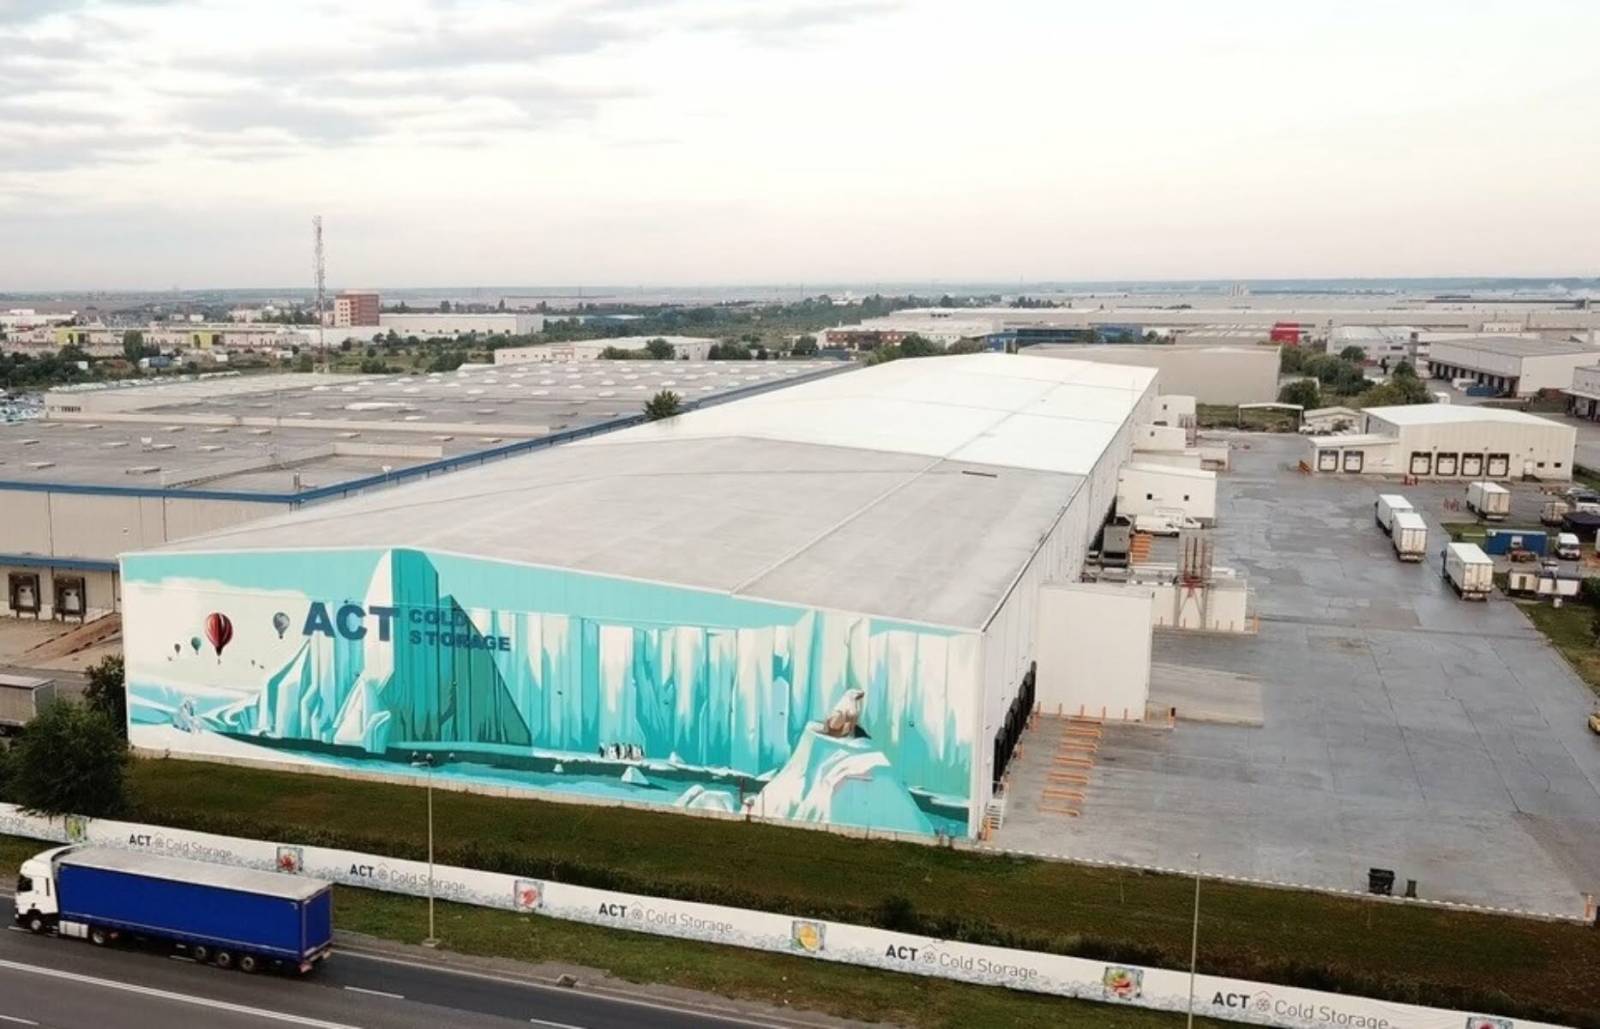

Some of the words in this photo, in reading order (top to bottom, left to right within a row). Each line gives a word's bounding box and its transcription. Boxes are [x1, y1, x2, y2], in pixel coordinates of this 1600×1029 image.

[302, 601, 399, 642] ACT
[408, 608, 466, 626] COLD
[408, 630, 511, 652] STORAGE
[129, 833, 152, 847] ACT
[165, 838, 190, 853] Cold
[191, 841, 233, 858] Storage
[350, 863, 374, 878] ACT
[390, 869, 417, 885] Cold
[418, 874, 466, 892] Storage
[599, 902, 627, 918] ACT
[645, 908, 677, 925] Cold
[679, 913, 734, 934] Storage
[885, 944, 918, 961] ACT
[939, 952, 974, 970] Cold
[976, 957, 1038, 982] Storage
[1212, 992, 1251, 1009] ACT
[1274, 999, 1314, 1020] Cold
[1318, 1005, 1389, 1029] Storage
